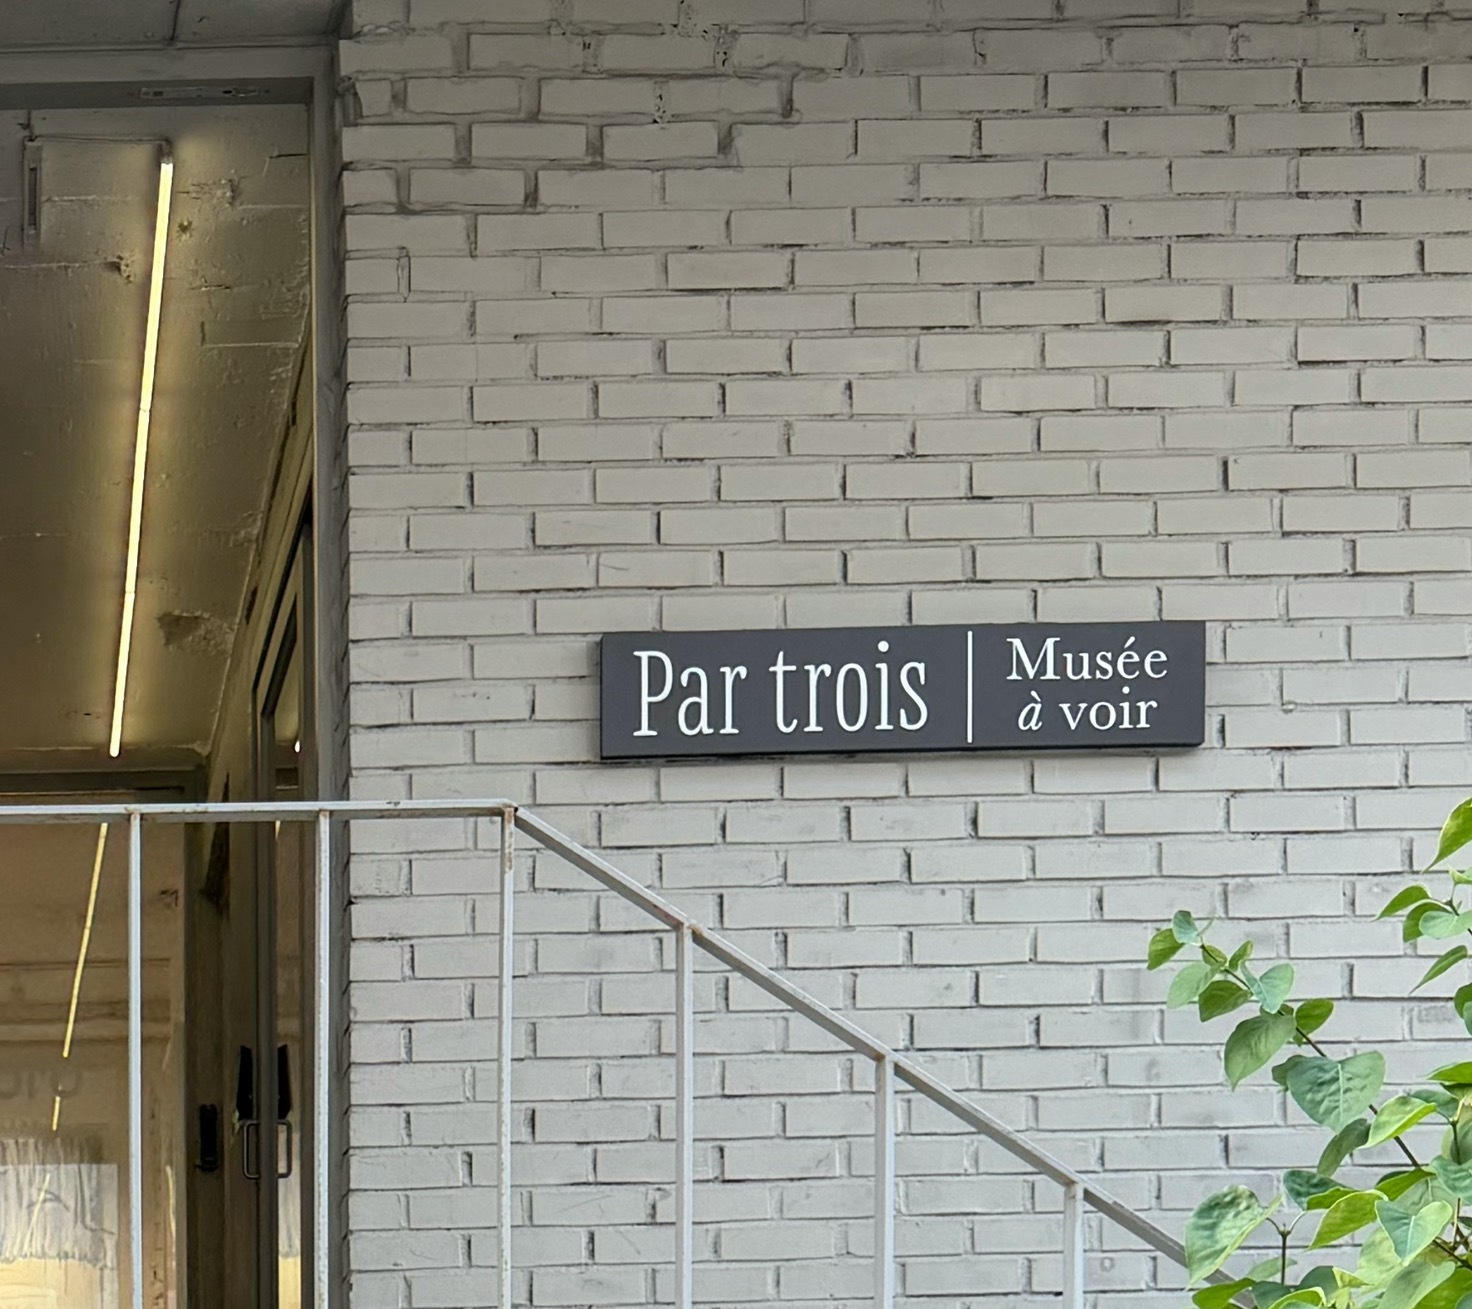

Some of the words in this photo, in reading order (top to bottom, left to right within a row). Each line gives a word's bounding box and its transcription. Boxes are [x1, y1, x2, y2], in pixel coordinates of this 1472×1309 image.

[1006, 635, 1169, 682] Musée
[632, 648, 748, 737] Par
[769, 640, 929, 733] trois
[1017, 690, 1043, 731] à
[1058, 685, 1159, 730] voir
